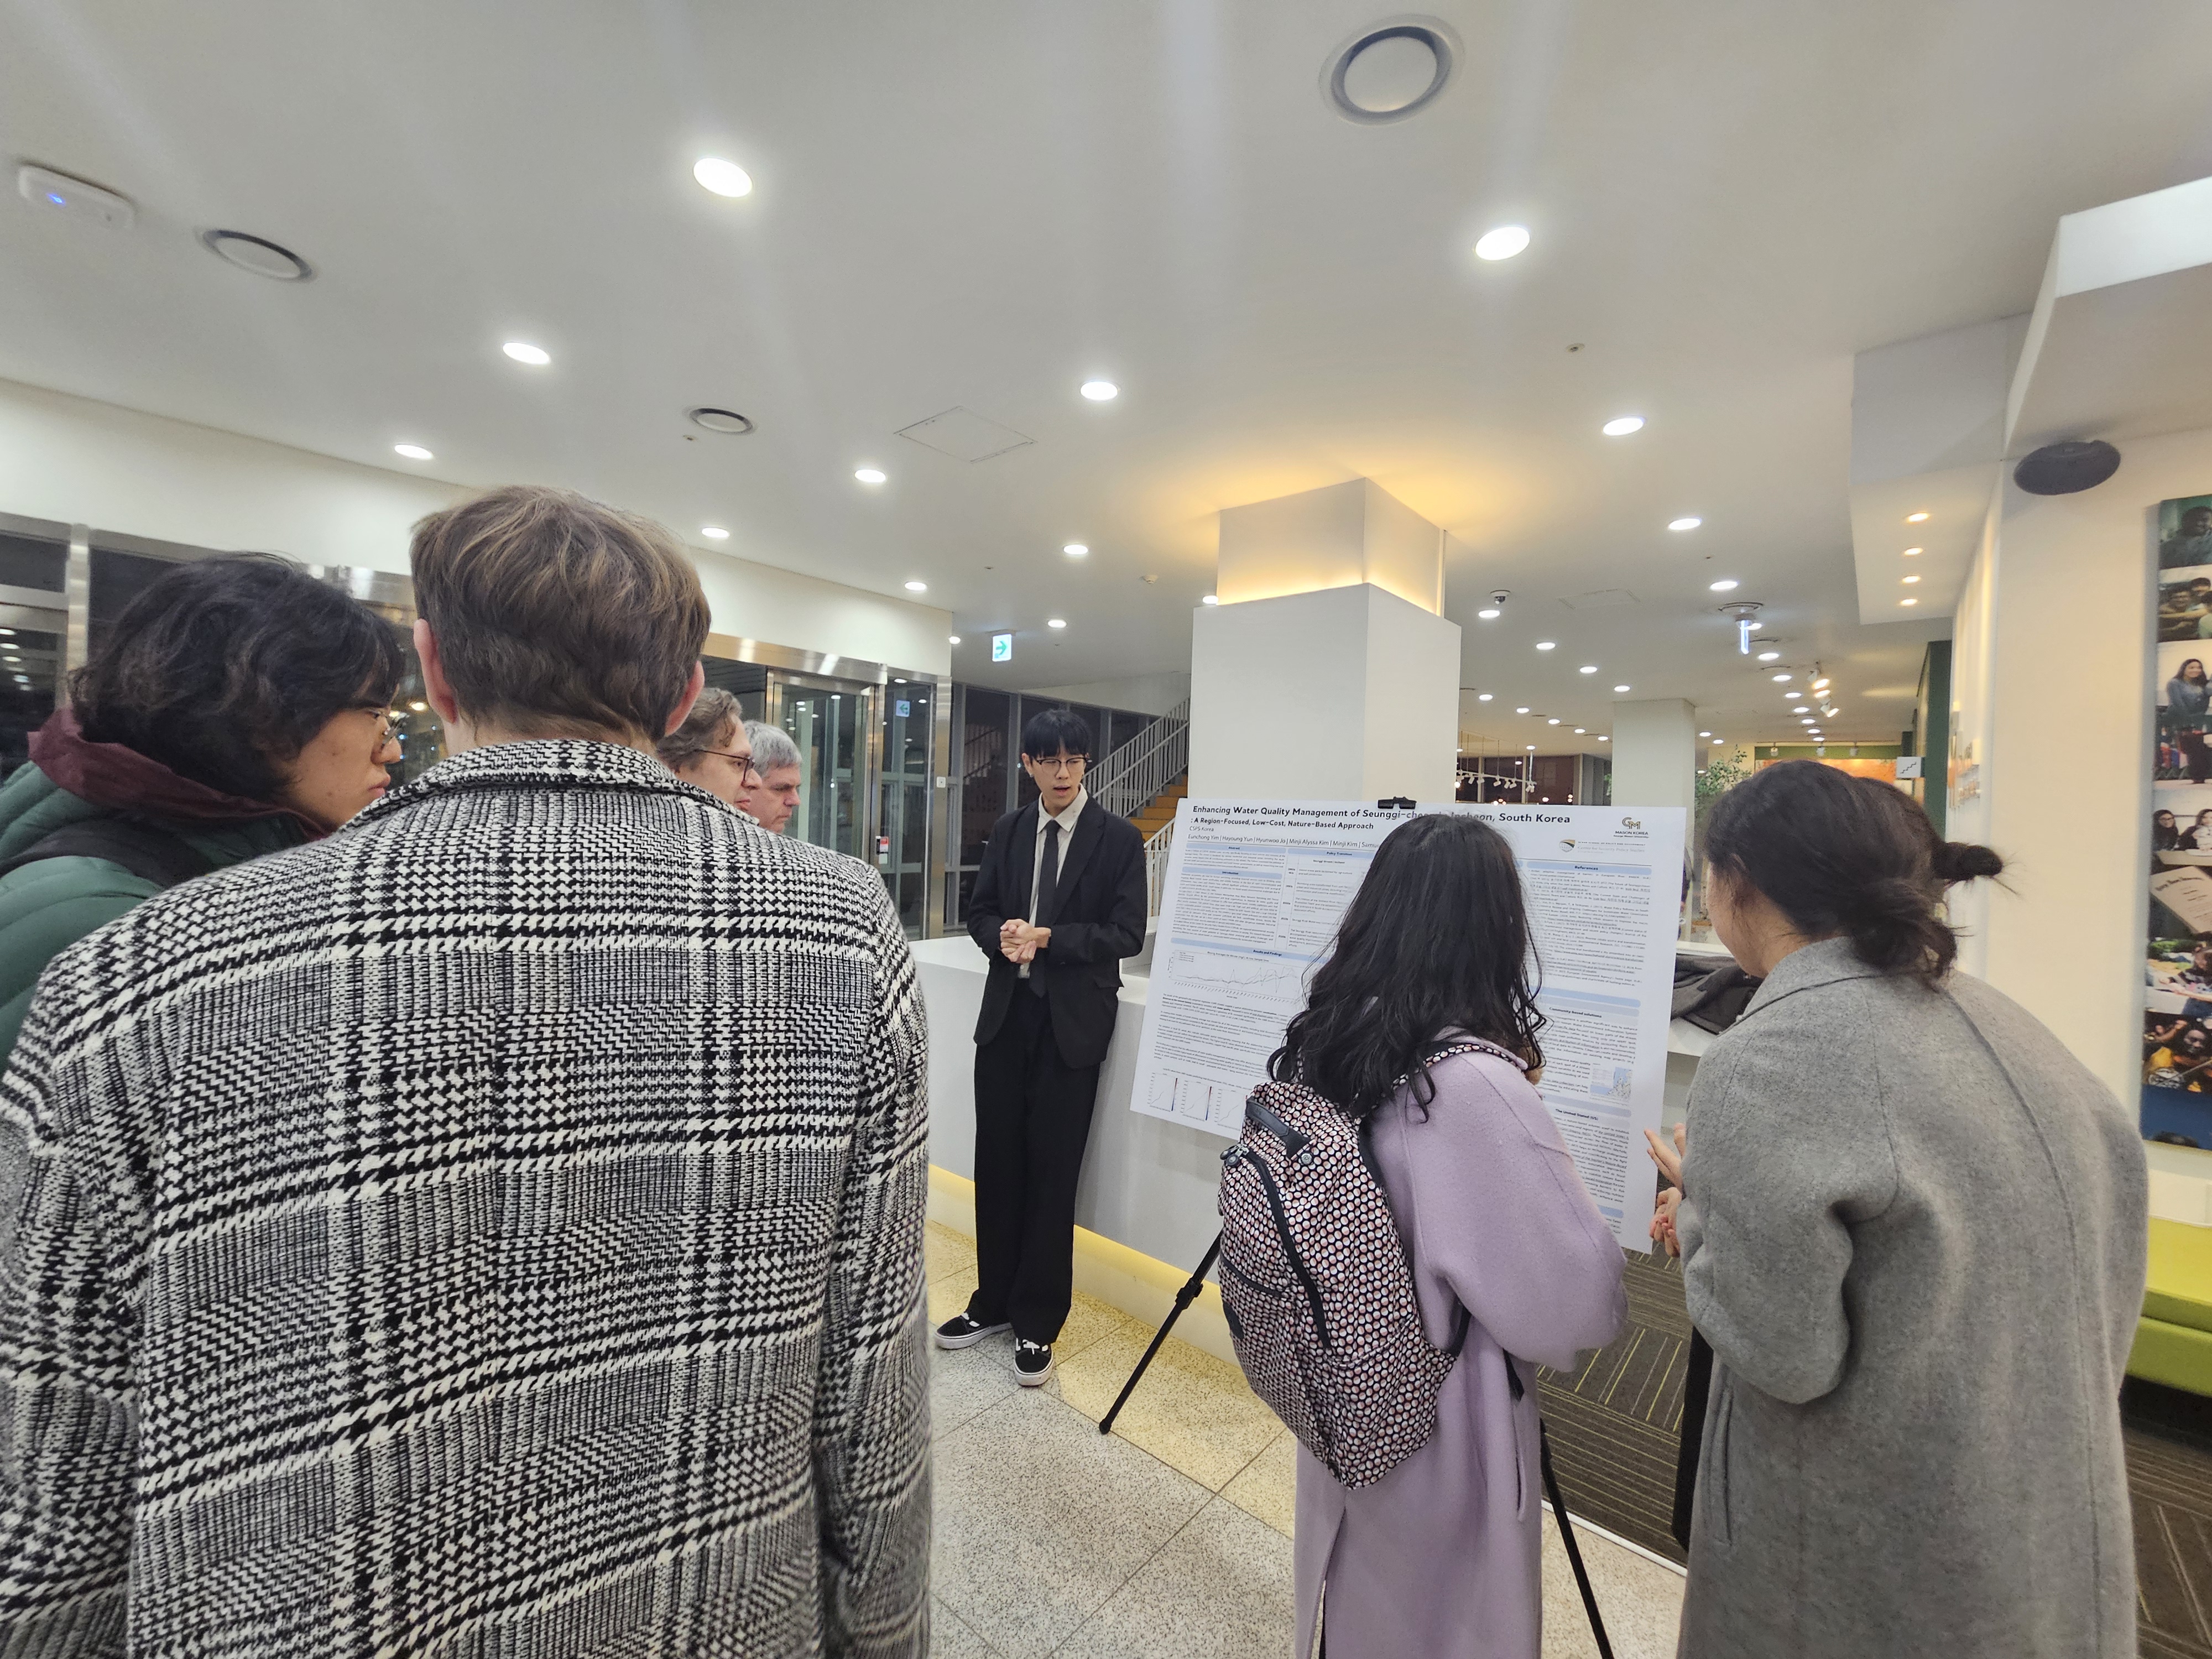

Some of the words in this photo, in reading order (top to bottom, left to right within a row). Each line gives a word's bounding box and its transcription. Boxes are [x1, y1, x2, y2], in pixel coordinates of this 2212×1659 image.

[1193, 806, 1230, 815] Enhancing
[1261, 807, 1290, 817] Quality
[1292, 808, 1348, 818] Management
[1499, 813, 1532, 822] South
[1536, 814, 1570, 823] Korea
